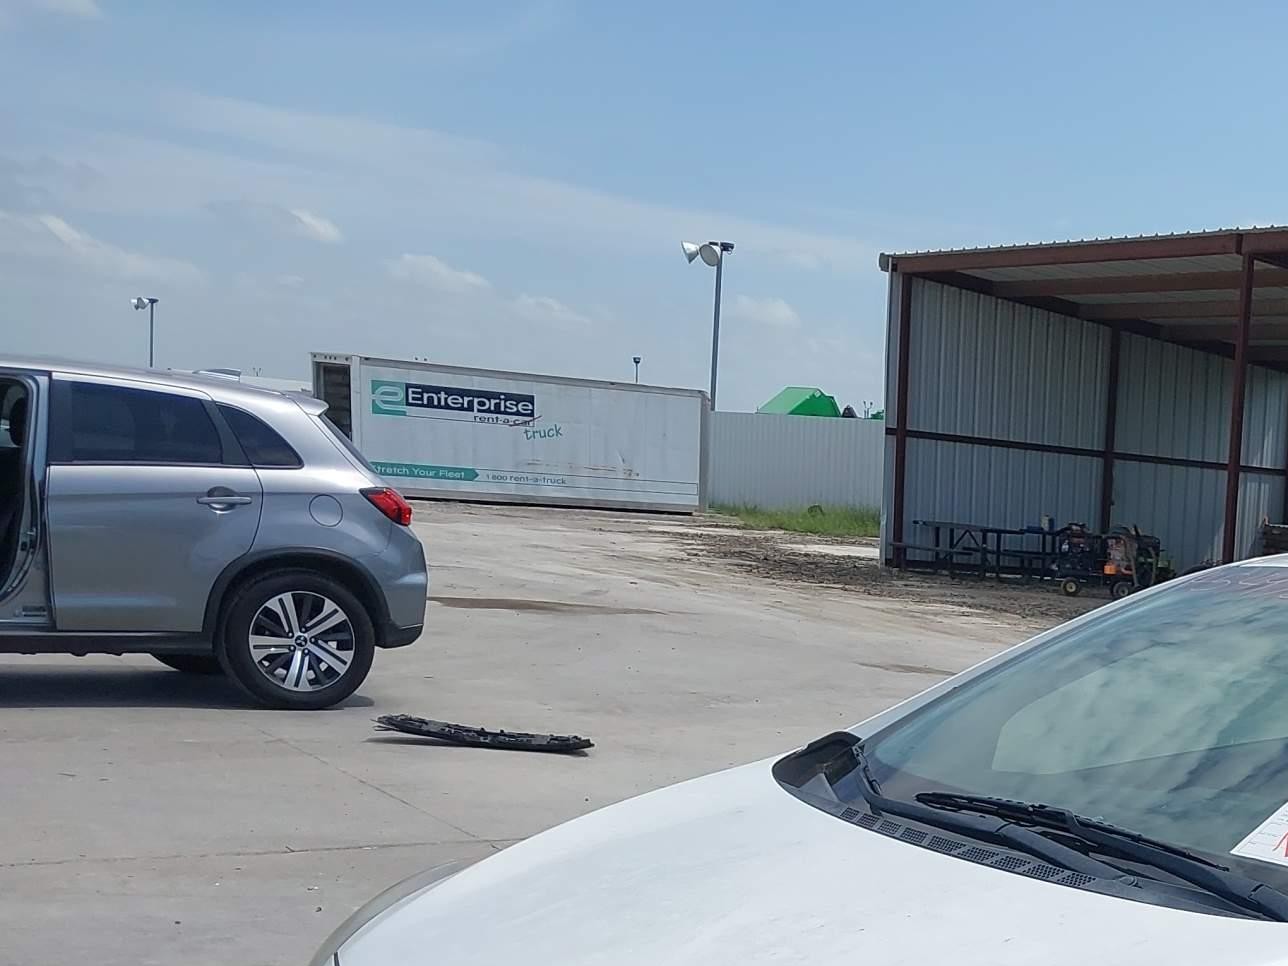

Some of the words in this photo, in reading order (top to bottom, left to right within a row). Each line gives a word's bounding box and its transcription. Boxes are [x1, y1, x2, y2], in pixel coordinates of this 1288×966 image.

[407, 387, 534, 414] Enterprise
[523, 424, 563, 441] truck
[375, 465, 409, 475] tretch
[412, 467, 437, 477] Your
[439, 469, 465, 479] Fleet
